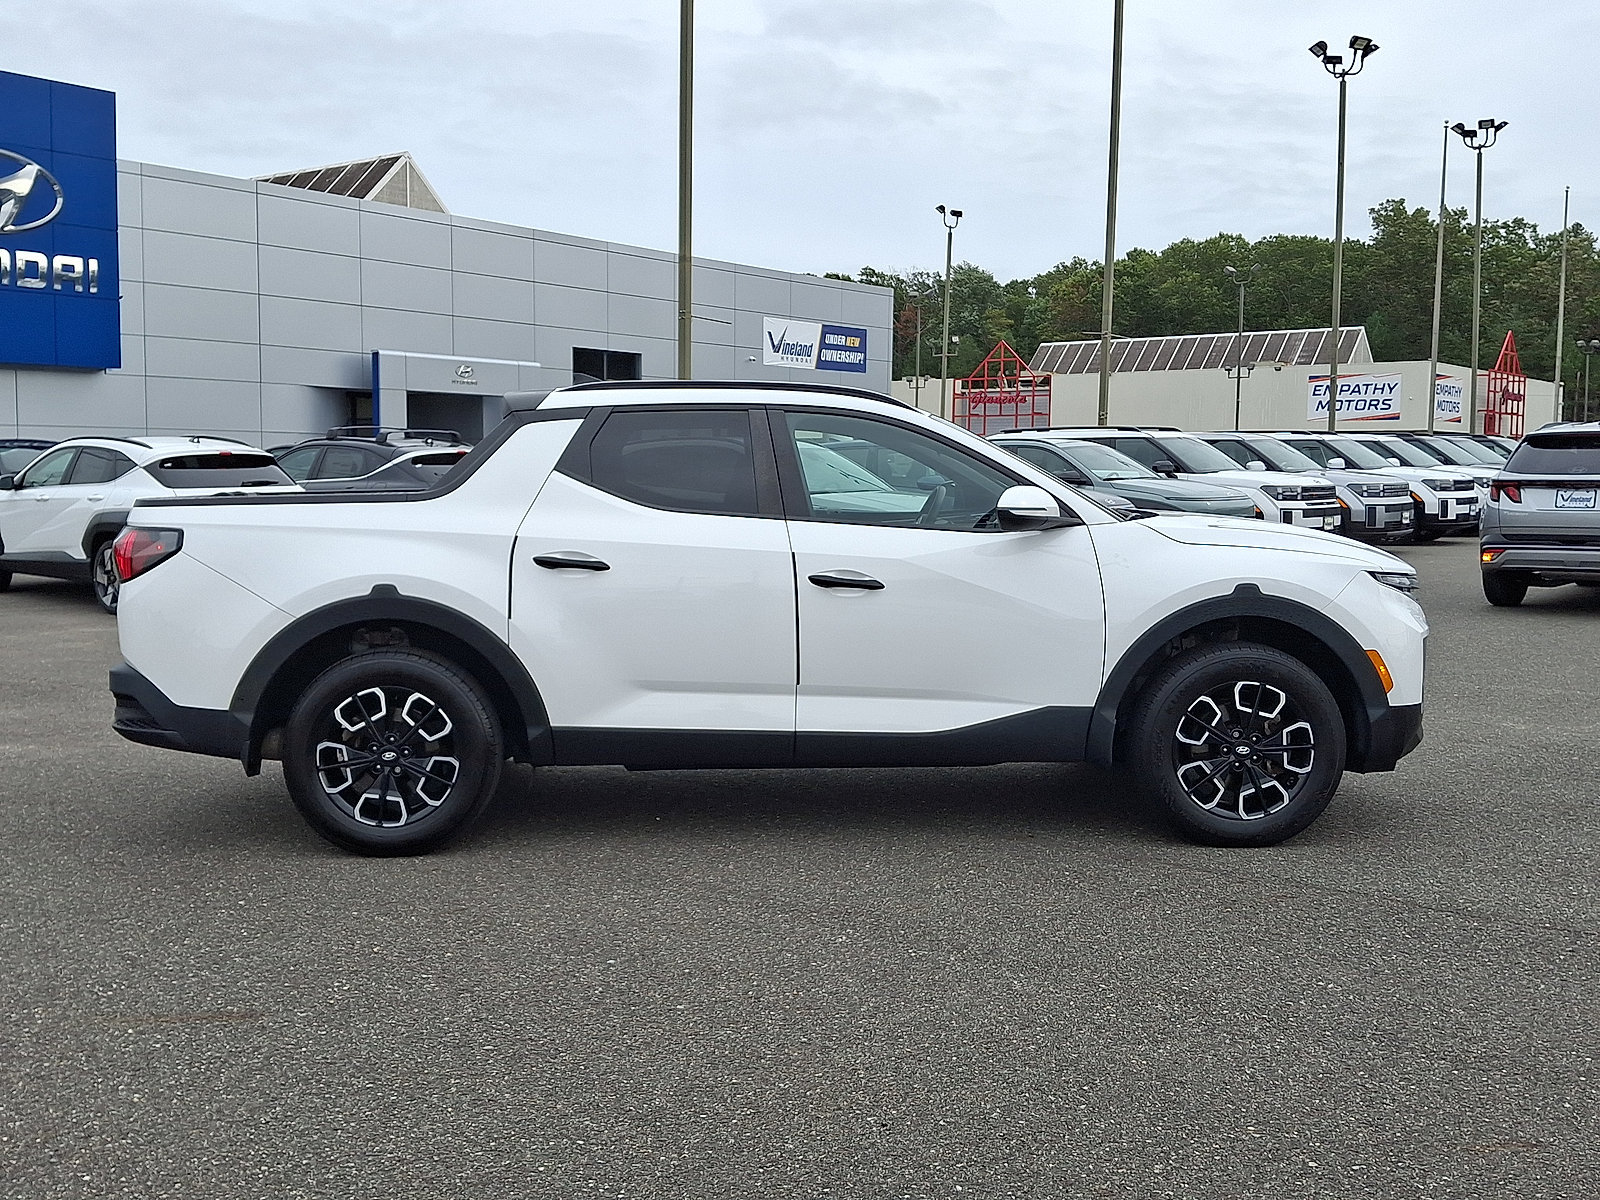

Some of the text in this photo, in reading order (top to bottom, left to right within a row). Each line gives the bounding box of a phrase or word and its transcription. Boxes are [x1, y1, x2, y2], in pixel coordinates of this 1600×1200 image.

[767, 325, 814, 358] Vineland
[825, 333, 861, 347] UNDER NEW
[781, 355, 812, 364] HYUNDAI
[820, 349, 864, 364] OWNERSHIP!
[1436, 383, 1463, 398] EMPATHY
[1315, 398, 1393, 412] MOTORS
[1436, 399, 1461, 413] MOTORS
